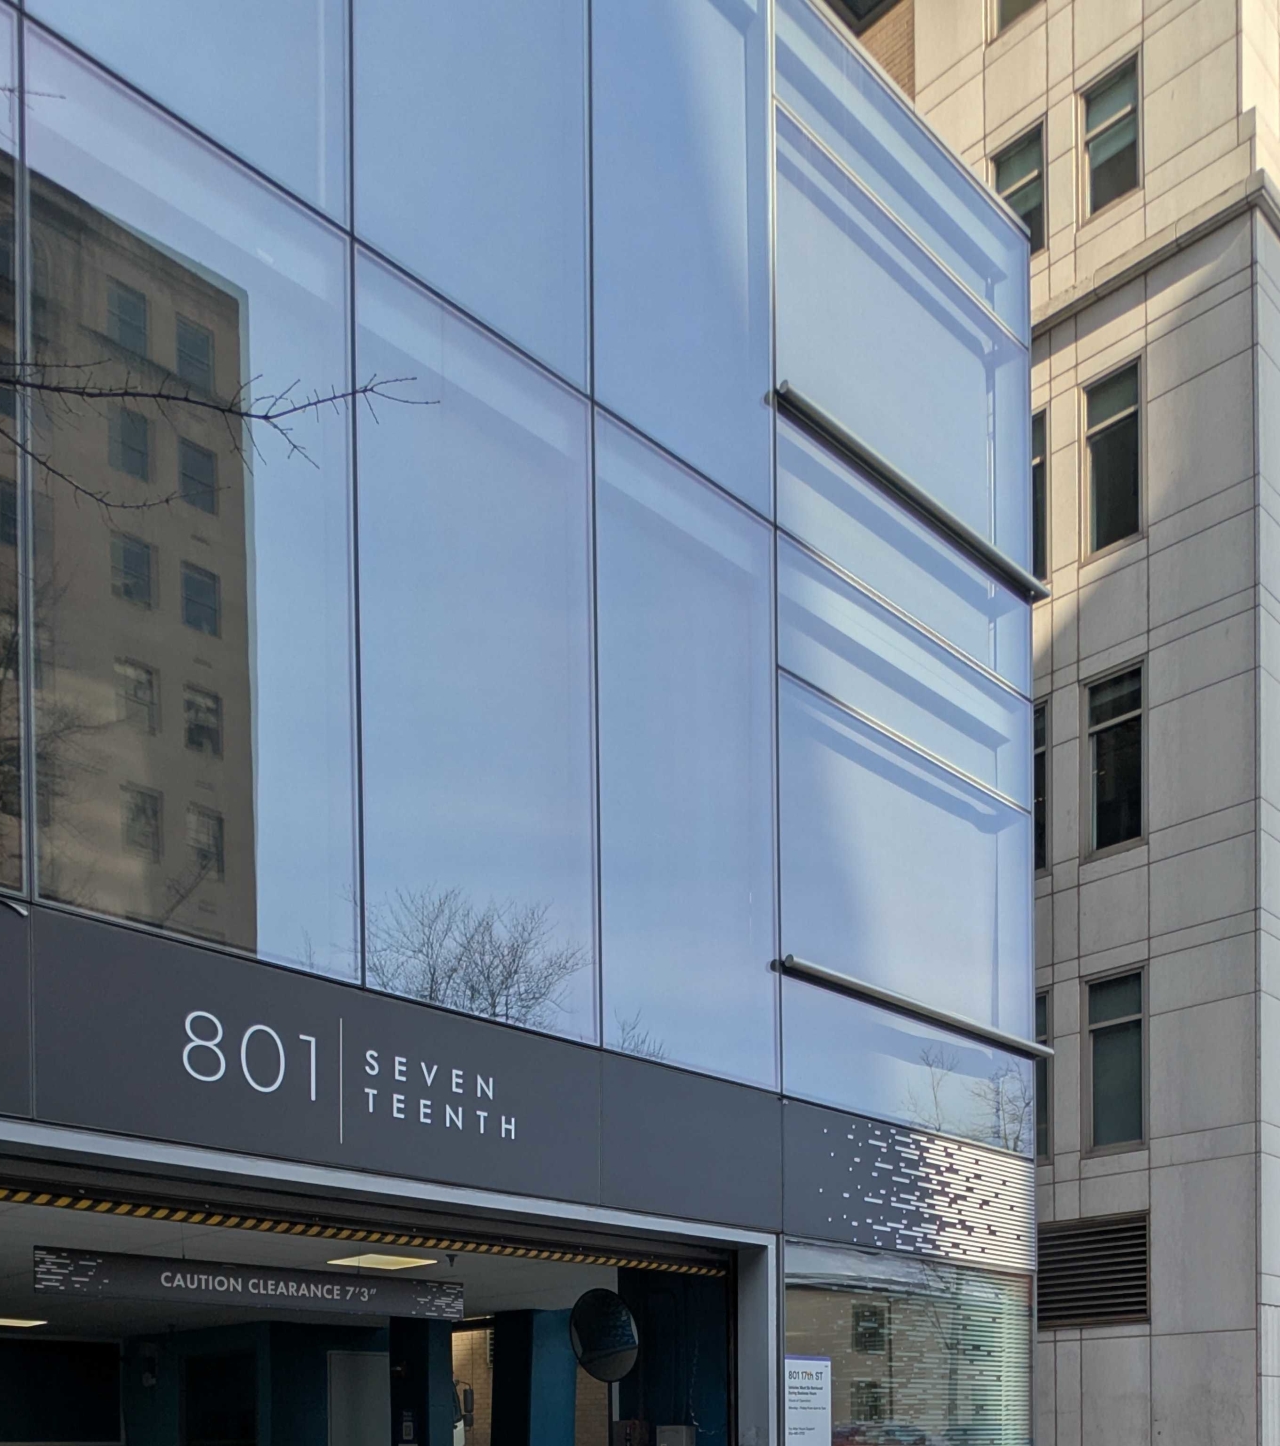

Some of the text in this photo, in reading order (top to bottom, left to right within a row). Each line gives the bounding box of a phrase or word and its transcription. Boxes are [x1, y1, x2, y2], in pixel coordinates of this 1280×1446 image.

[182, 1010, 317, 1101] 801
[363, 1049, 494, 1100] SEVEN
[363, 1087, 516, 1140] TEENTH
[160, 1271, 243, 1294] CAUTION
[248, 1277, 341, 1300] CLEARANCE
[788, 1370, 823, 1381] 801 17th ST
